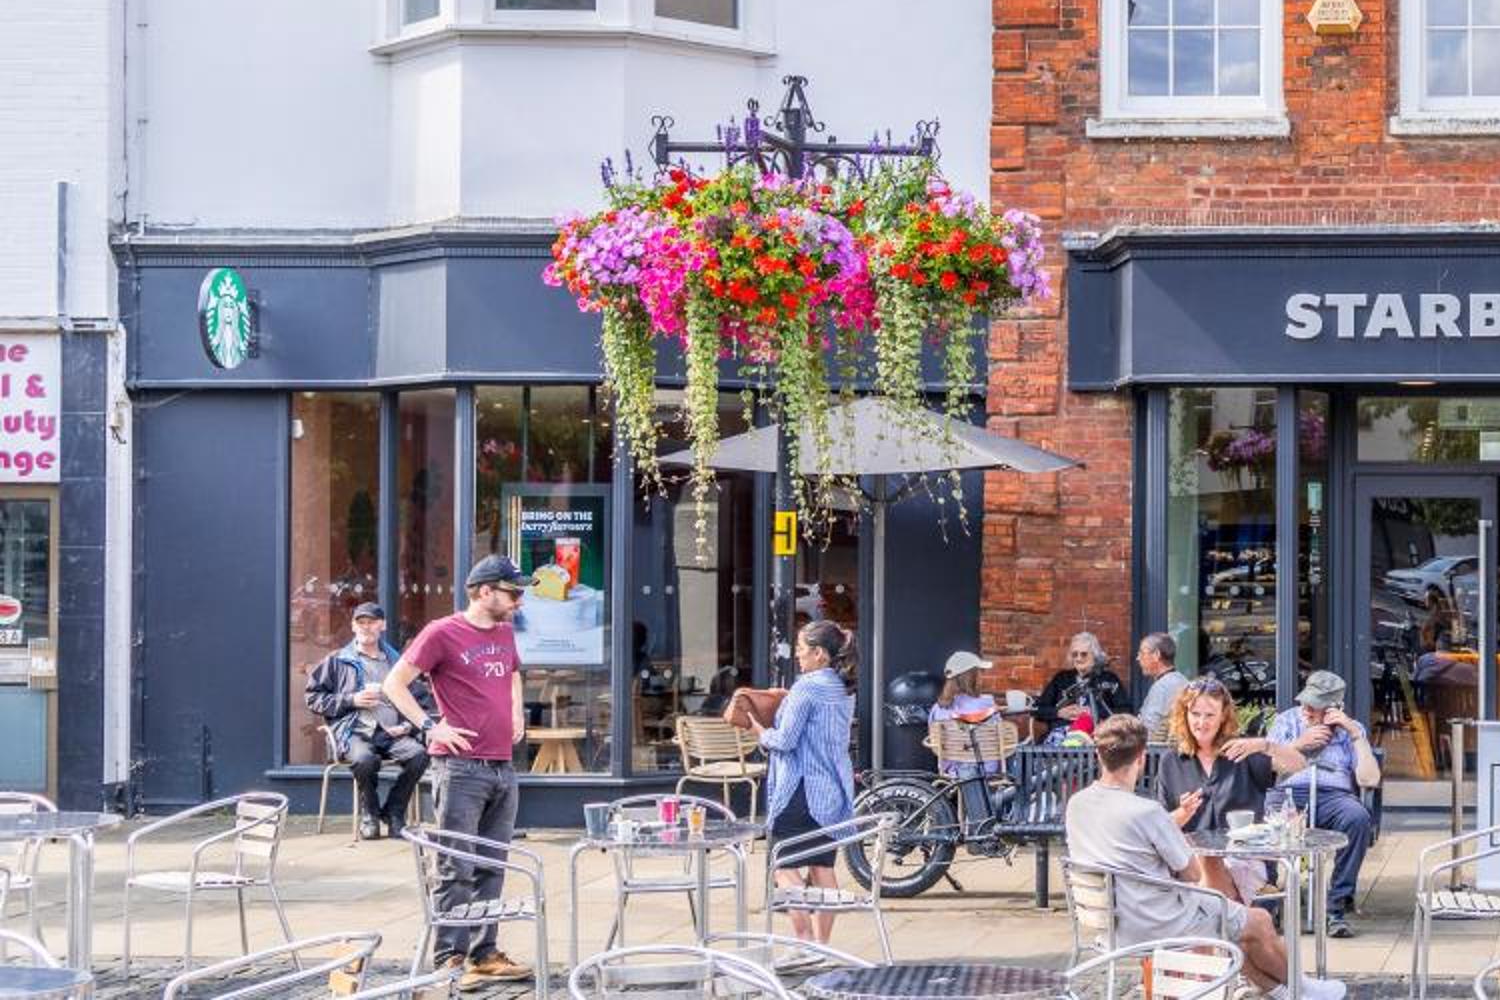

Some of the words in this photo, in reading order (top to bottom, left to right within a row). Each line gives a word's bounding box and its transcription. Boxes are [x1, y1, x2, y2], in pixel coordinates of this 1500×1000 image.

[25, 374, 46, 398] &
[0, 410, 56, 441] uty
[522, 511, 554, 521] BRING
[555, 511, 573, 521] ON
[574, 511, 593, 521] THE
[484, 661, 505, 678] 70
